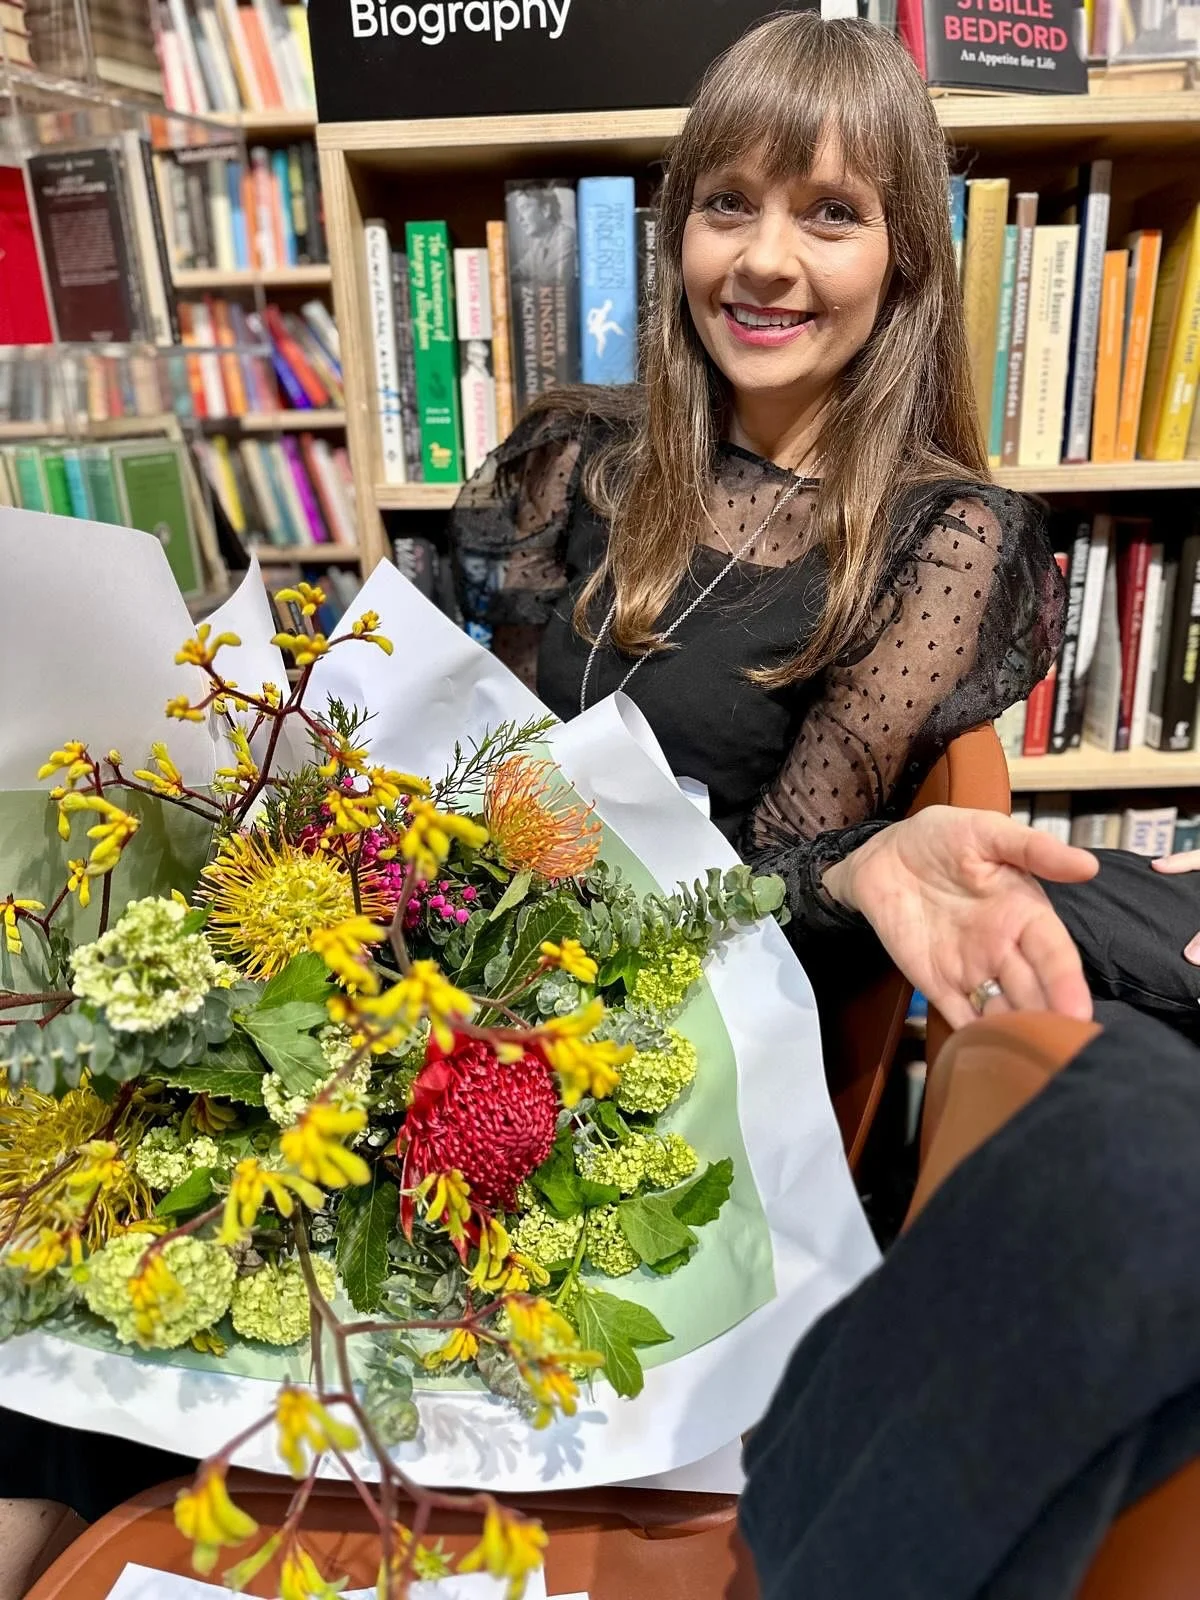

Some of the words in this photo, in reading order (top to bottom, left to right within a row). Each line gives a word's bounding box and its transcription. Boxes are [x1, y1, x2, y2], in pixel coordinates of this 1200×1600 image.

[350, 0, 571, 45] Biography
[944, 15, 1068, 51] BEDFORD
[960, 49, 976, 61] An
[977, 51, 1019, 67] Appetite
[1020, 55, 1035, 67] for
[1036, 56, 1056, 70] Life
[429, 233, 447, 257] The
[643, 220, 656, 250] JOHN
[1017, 227, 1033, 279] MICHAEL
[1054, 240, 1070, 274] Simone
[411, 233, 427, 288] Margery
[430, 260, 446, 328] Adventures
[413, 290, 433, 350] Allingham
[433, 328, 450, 342] of
[540, 286, 558, 369] KINGSLEY
[1006, 351, 1022, 418] Episodes
